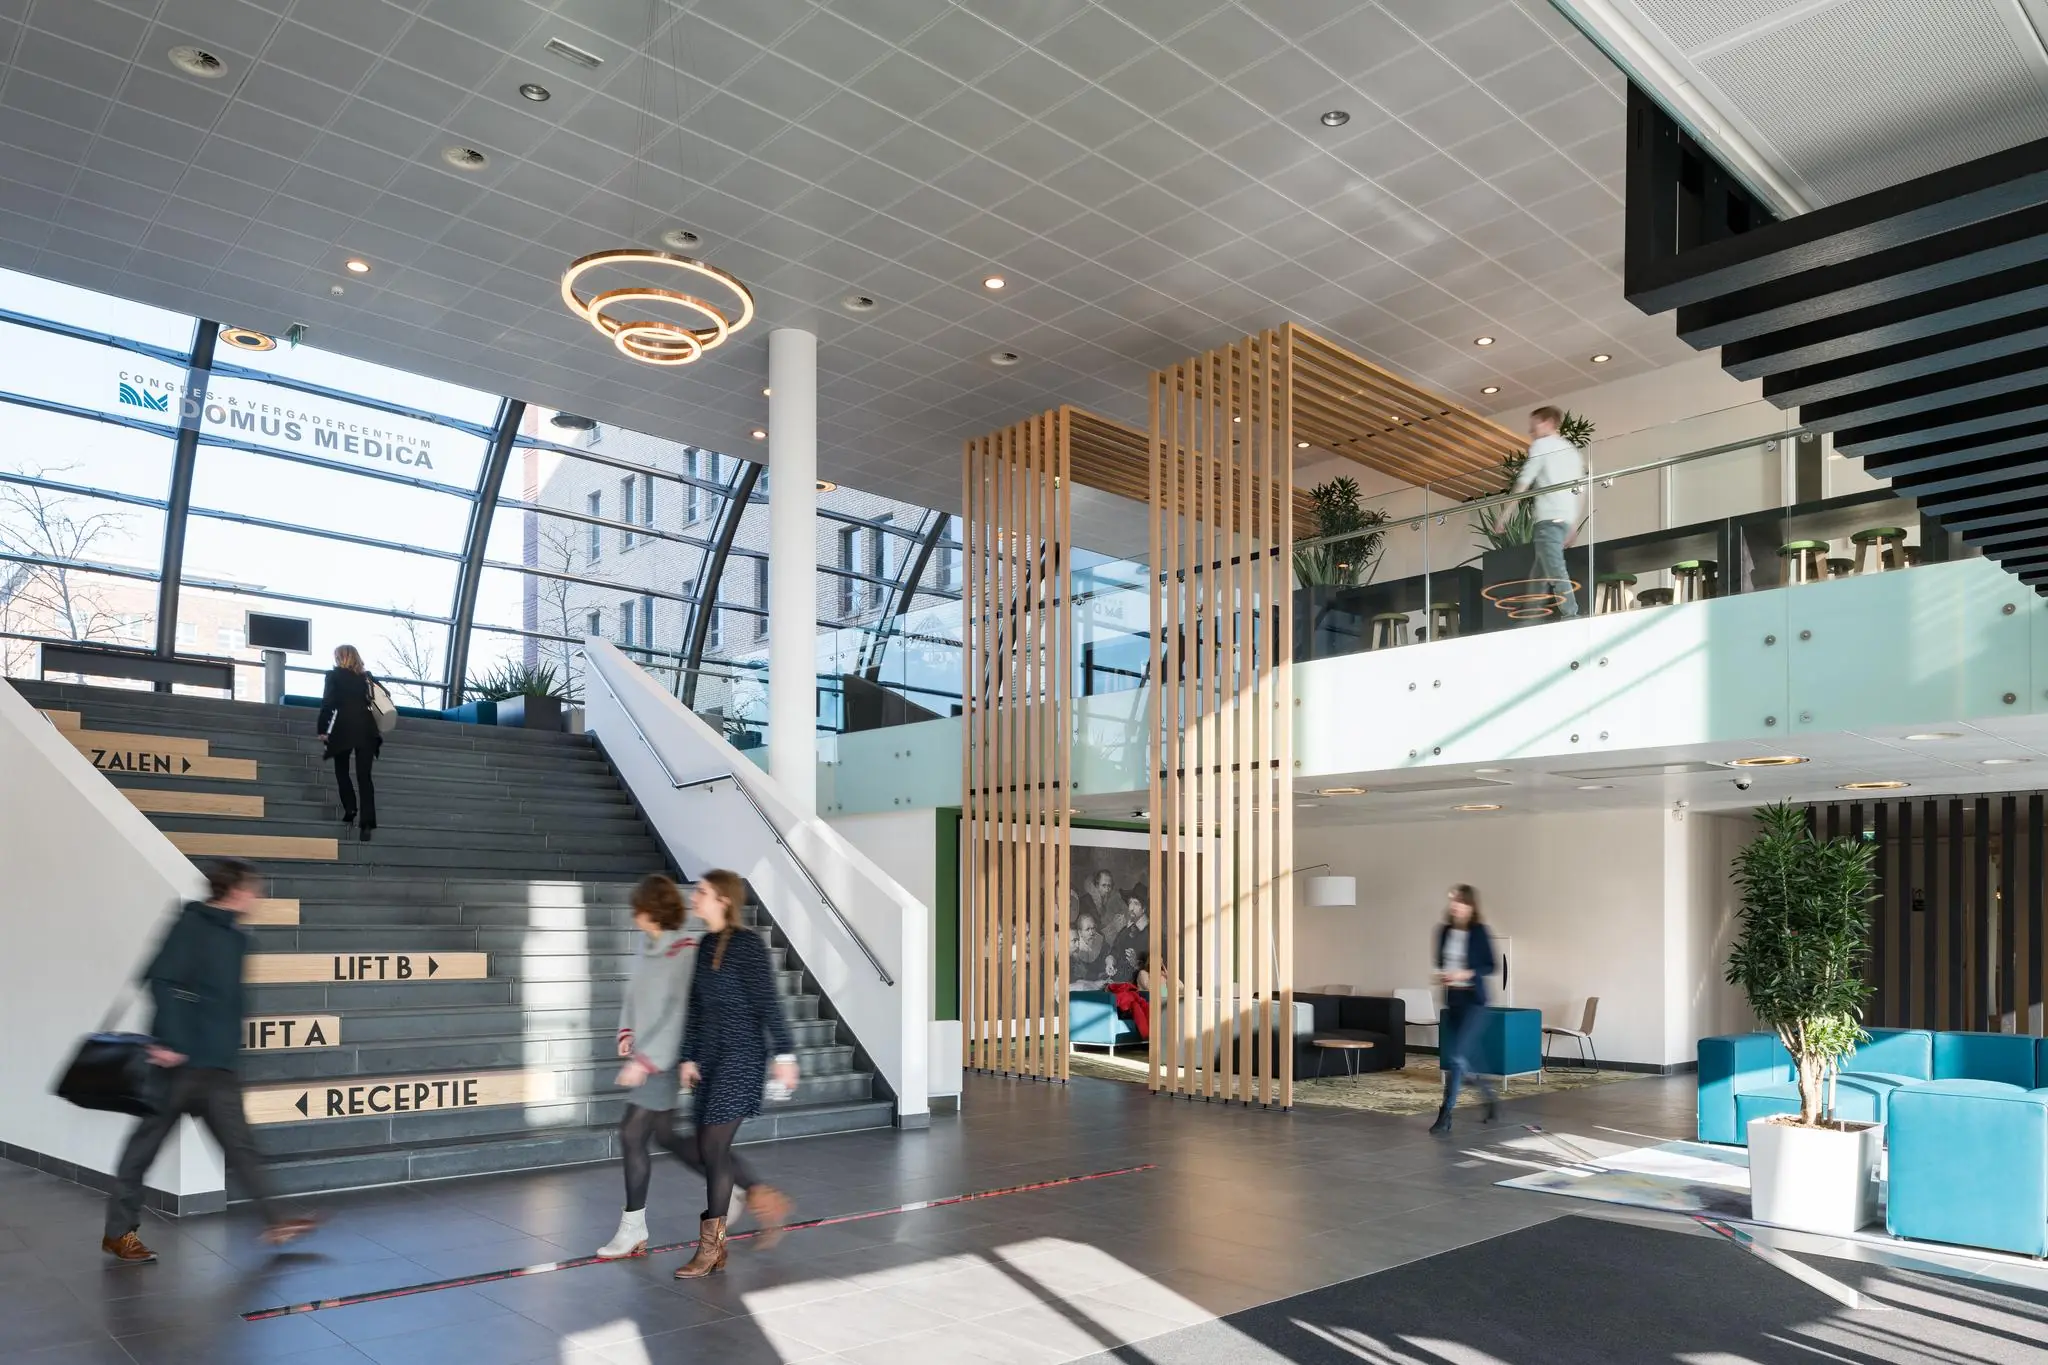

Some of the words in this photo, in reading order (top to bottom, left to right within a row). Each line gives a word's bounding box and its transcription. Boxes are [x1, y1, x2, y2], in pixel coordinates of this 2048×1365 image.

[179, 397, 301, 441] DOMUS
[315, 428, 433, 469] MEDICA
[228, 396, 238, 406] &
[248, 401, 431, 448] VERGADERCENTRUM
[91, 749, 170, 773] ZALEN
[334, 956, 389, 980] LIFT
[397, 956, 412, 979] B
[240, 1020, 296, 1049] IFT
[304, 1019, 327, 1046] A
[327, 1079, 477, 1117] RECEPTIE
